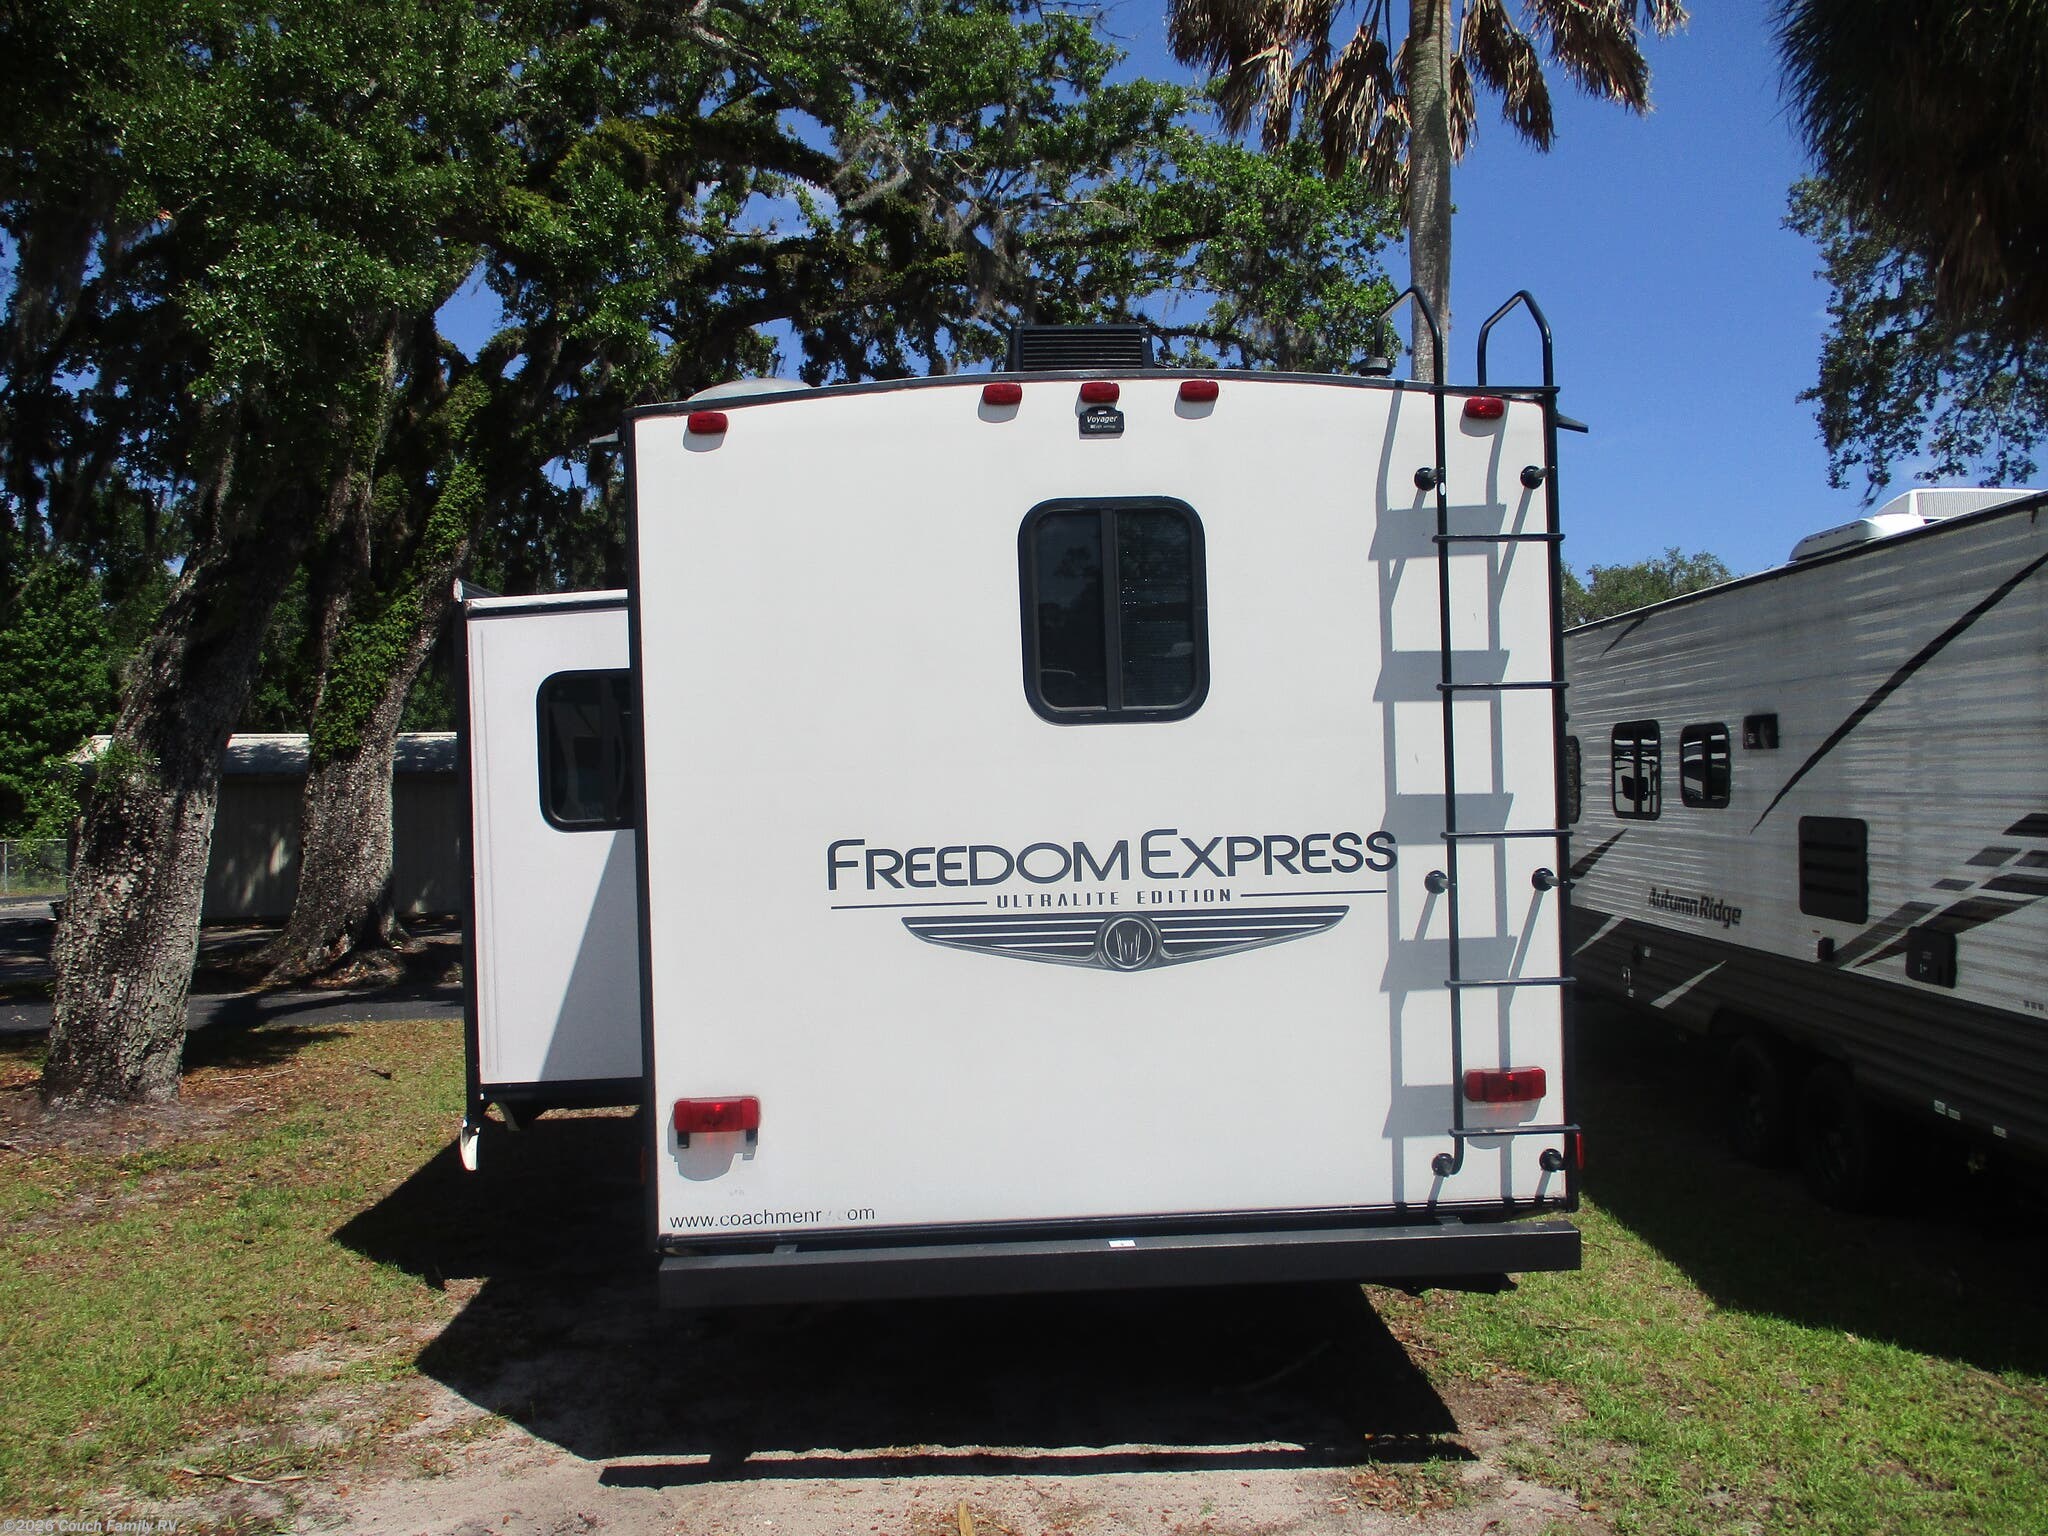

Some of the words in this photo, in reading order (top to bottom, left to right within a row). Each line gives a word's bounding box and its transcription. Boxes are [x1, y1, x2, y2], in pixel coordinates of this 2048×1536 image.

[1086, 415, 1118, 424] Voyager
[827, 838, 1130, 890] FREEDOM
[1140, 828, 1398, 879] EXPRESS
[996, 891, 1119, 909] ULTRALITE
[1137, 888, 1231, 905] EDITION
[1648, 886, 1699, 915] Autumn
[1700, 894, 1742, 929] Ridge
[670, 1208, 875, 1228] www.coachmenrom
